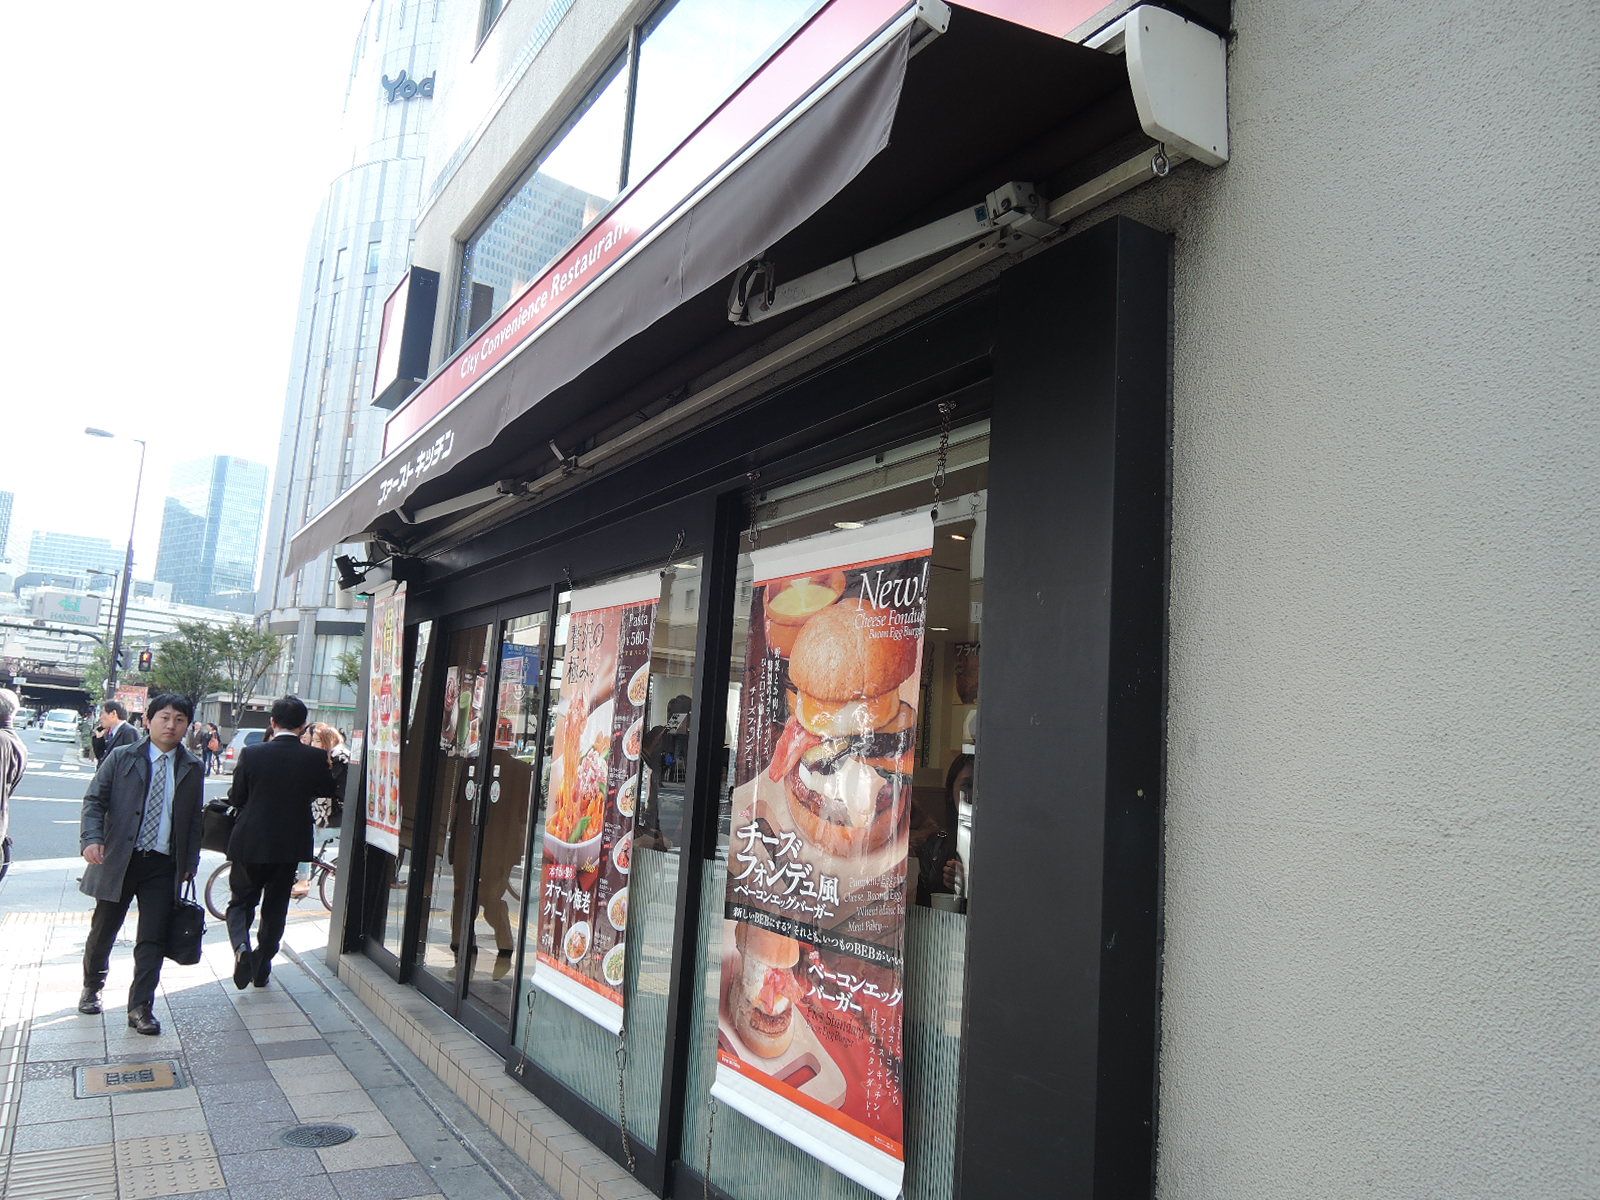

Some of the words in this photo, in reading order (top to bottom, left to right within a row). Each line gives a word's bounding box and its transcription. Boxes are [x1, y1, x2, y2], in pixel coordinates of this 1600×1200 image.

[460, 349, 481, 379] City
[480, 290, 550, 361] Convenience
[856, 561, 929, 611] New!
[854, 613, 887, 630] Cheese
[889, 626, 903, 640] Egg
[737, 821, 803, 859] チーズ
[734, 854, 840, 906] フォンデュ風
[733, 884, 835, 919] ベーコンエッグバーガー
[806, 985, 862, 1012] バーガー
[808, 964, 903, 1007] ベーコンエッグ
